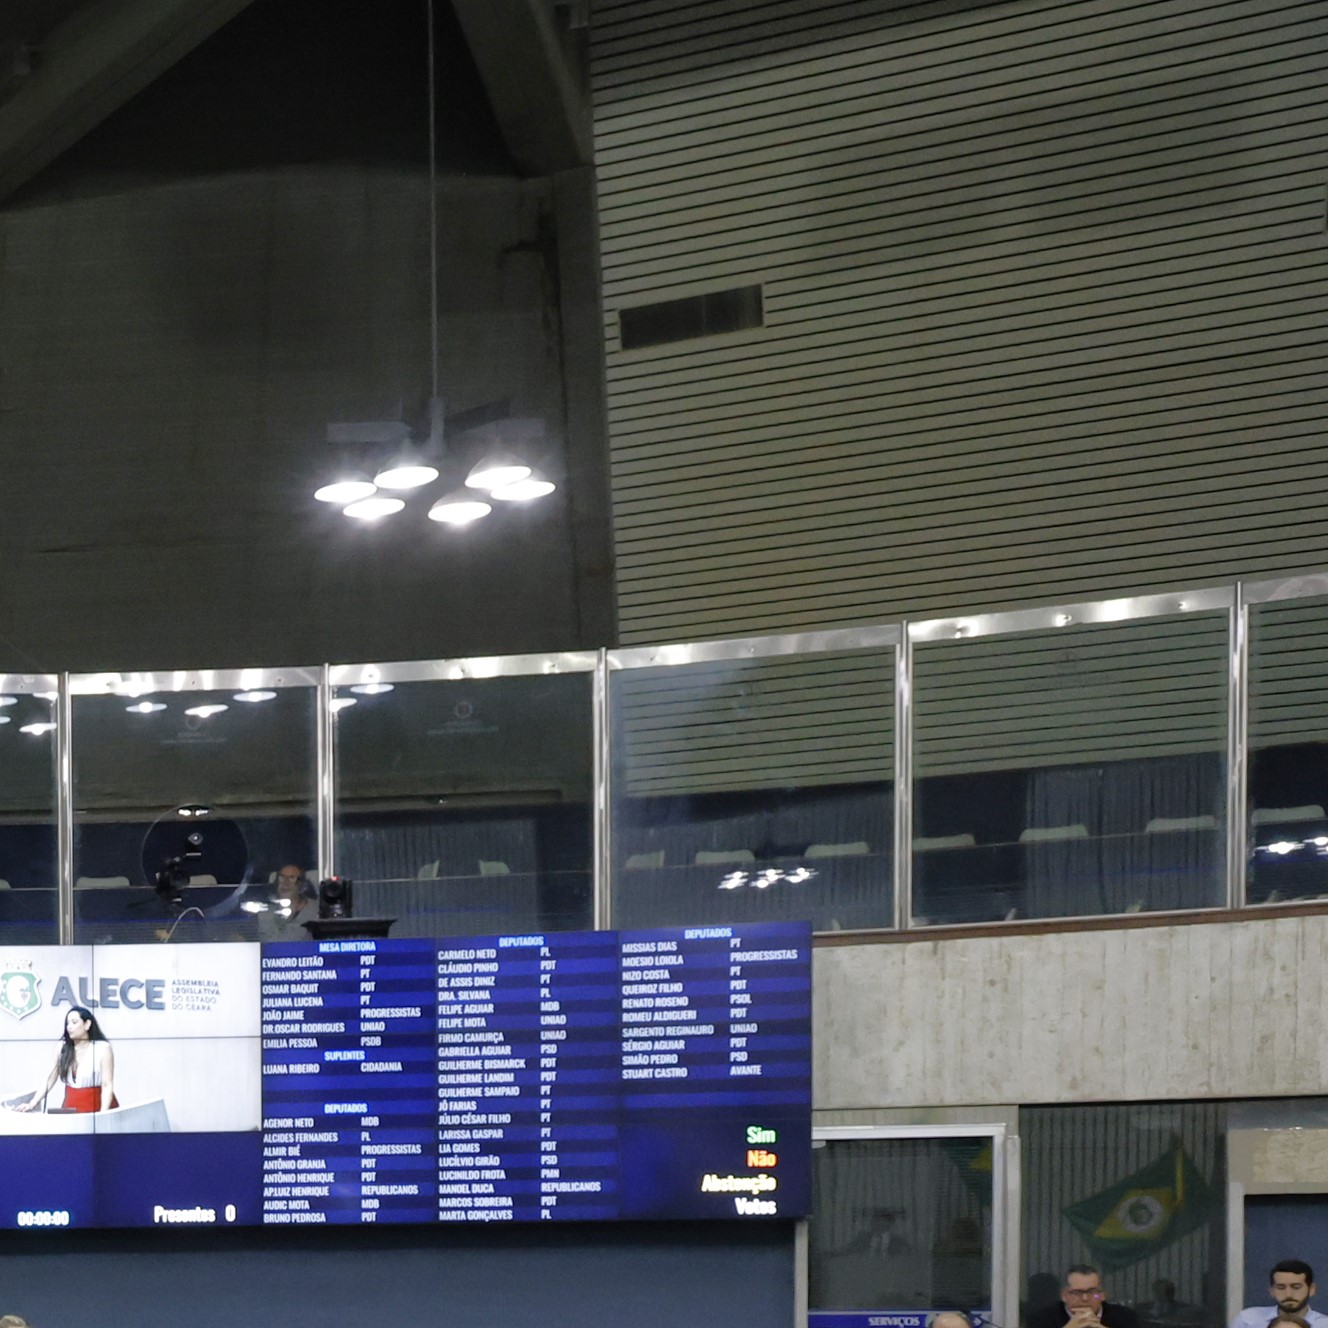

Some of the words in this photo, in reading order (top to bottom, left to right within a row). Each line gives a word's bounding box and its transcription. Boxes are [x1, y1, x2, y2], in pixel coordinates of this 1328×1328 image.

[684, 928, 732, 939] DEPUTADOS
[319, 943, 340, 952] MESA
[341, 942, 376, 952] DIRETORA
[499, 937, 544, 947] DEPUTADOS
[622, 943, 656, 953] MISSIAS
[658, 942, 677, 951] DIAS
[438, 950, 475, 960] CARMELO
[476, 949, 496, 958] NETO
[655, 955, 683, 966] LOIOLA
[730, 950, 797, 962] PROGRESSISTAS
[263, 958, 297, 967] EVANDRO
[299, 956, 323, 967] LEITÃO
[438, 962, 472, 973] CLÁUDIO
[474, 962, 498, 972] PINHO
[263, 971, 301, 981] FERNANDO
[303, 970, 337, 980] SANTANA
[361, 969, 370, 978] PT
[622, 971, 641, 981] NIZO
[643, 970, 670, 979] COSTA
[172, 979, 219, 987] ASSEMBLEIA
[438, 978, 448, 987] DE
[450, 977, 472, 987] ASSIS
[474, 976, 495, 986] DINIZ
[51, 976, 165, 1010] ALECE
[172, 987, 220, 995] LEGISLATIVA
[263, 985, 289, 994] OSMAR
[291, 984, 318, 994] BAQUIT
[622, 985, 657, 995] QUEIROZ
[659, 983, 683, 993] FILHO
[730, 980, 746, 990] PDT
[458, 990, 490, 1000] SILVANA
[263, 998, 292, 1007] JULIANA
[294, 997, 323, 1007] LUCENA
[622, 998, 653, 1009] RENATO
[655, 997, 688, 1007] ROSENO
[730, 994, 751, 1004] PSOL
[438, 1005, 462, 1014] FELIPE
[464, 1004, 493, 1013] AGUIAR
[541, 1002, 559, 1011] MDB
[263, 1011, 281, 1021] JOÃO
[283, 1010, 304, 1020] JAIME
[361, 1008, 421, 1018] PROGRESSISTAS
[622, 1012, 651, 1022] ROMEU
[653, 1010, 696, 1021] ALDIGUERI
[730, 1008, 746, 1018] PDT
[302, 1023, 345, 1033] RODRIGUES
[438, 1019, 462, 1028] FELIPE
[464, 1018, 486, 1027] MOTA
[622, 1027, 664, 1037] SARGENTO
[666, 1025, 714, 1036] REGINAURO
[289, 1038, 318, 1047] PESSOA
[361, 1037, 381, 1046] PSDB
[438, 1034, 463, 1043] FIRMO
[465, 1032, 504, 1043] CAMURÇA
[622, 1040, 652, 1051] SÉRGIO
[654, 1040, 685, 1050] AGUIAR
[730, 1038, 746, 1048] PDT
[325, 1051, 365, 1061] SUPLENTES
[438, 1047, 480, 1057] GABRIELLA
[482, 1046, 511, 1055] AGUIAR
[541, 1044, 557, 1054] PSD
[622, 1054, 649, 1065] SIMÃO
[651, 1055, 678, 1064] PEDRO
[730, 1052, 747, 1062] PSD
[263, 1065, 287, 1074] LUANA
[289, 1064, 319, 1073] RIBEIRO
[361, 1062, 402, 1072] CIDADANIA
[438, 1061, 482, 1070] GUILHERME
[484, 1059, 526, 1069] BISMARCK
[622, 1069, 653, 1079] STUART
[655, 1068, 687, 1078] CASTRO
[730, 1065, 762, 1076] AVANTE
[438, 1074, 482, 1084] GUILHERME
[484, 1073, 514, 1082] LANDIM
[438, 1088, 482, 1098] GUILHERME
[484, 1087, 519, 1096] SAMPAIO
[325, 1104, 367, 1113] DEPUTADOS
[449, 1101, 476, 1111] FARIAS
[263, 1118, 293, 1128] AGENOR
[295, 1118, 314, 1127] NETO
[361, 1117, 379, 1126] MDB
[462, 1113, 486, 1124] CÉSAR
[488, 1114, 511, 1123] FILHO
[263, 1133, 294, 1143] ALCIDES
[295, 1133, 338, 1142] FERNANDES
[361, 1131, 371, 1141] PL
[439, 1130, 471, 1140] LARISSA
[473, 1129, 503, 1139] GASPAR
[747, 1126, 775, 1143] Sim
[263, 1147, 286, 1156] ALMIR
[288, 1144, 300, 1156] BIÉ
[361, 1145, 421, 1155] PROGRESSISTAS
[439, 1144, 451, 1153] LIA
[453, 1143, 480, 1153] GOMES
[475, 1155, 500, 1166] GIRÃO
[541, 1155, 557, 1165] PSD
[747, 1150, 776, 1167] Não
[297, 1160, 326, 1169] GRANJA
[297, 1173, 334, 1183] HENRIQUE
[361, 1172, 376, 1182] PDT
[439, 1171, 479, 1180] LUCINILDO
[482, 1170, 506, 1179] FROTA
[439, 1184, 470, 1194] MANOEL
[472, 1184, 494, 1193] DUCA
[541, 1182, 601, 1192] REPUBLICANOS
[701, 1174, 776, 1194] Abstenção
[292, 1186, 329, 1196] HENRIQUE
[361, 1185, 418, 1195] REPUBLICANOS
[263, 1201, 287, 1210] AUDIC
[289, 1200, 310, 1209] MOTA
[361, 1199, 379, 1209] MDB
[439, 1198, 472, 1208] MARCOS
[474, 1197, 513, 1207] SOBREIRA
[735, 1197, 777, 1214] Votos
[154, 1205, 216, 1222] Presentes
[225, 1204, 235, 1222] 0
[264, 1214, 290, 1223] BRUNO
[292, 1213, 326, 1222] PEDROSA
[361, 1212, 376, 1221] PDT
[439, 1211, 466, 1221] MARTA
[468, 1210, 513, 1222] GONÇALVES
[868, 1317, 920, 1328] SERVIÇOS
